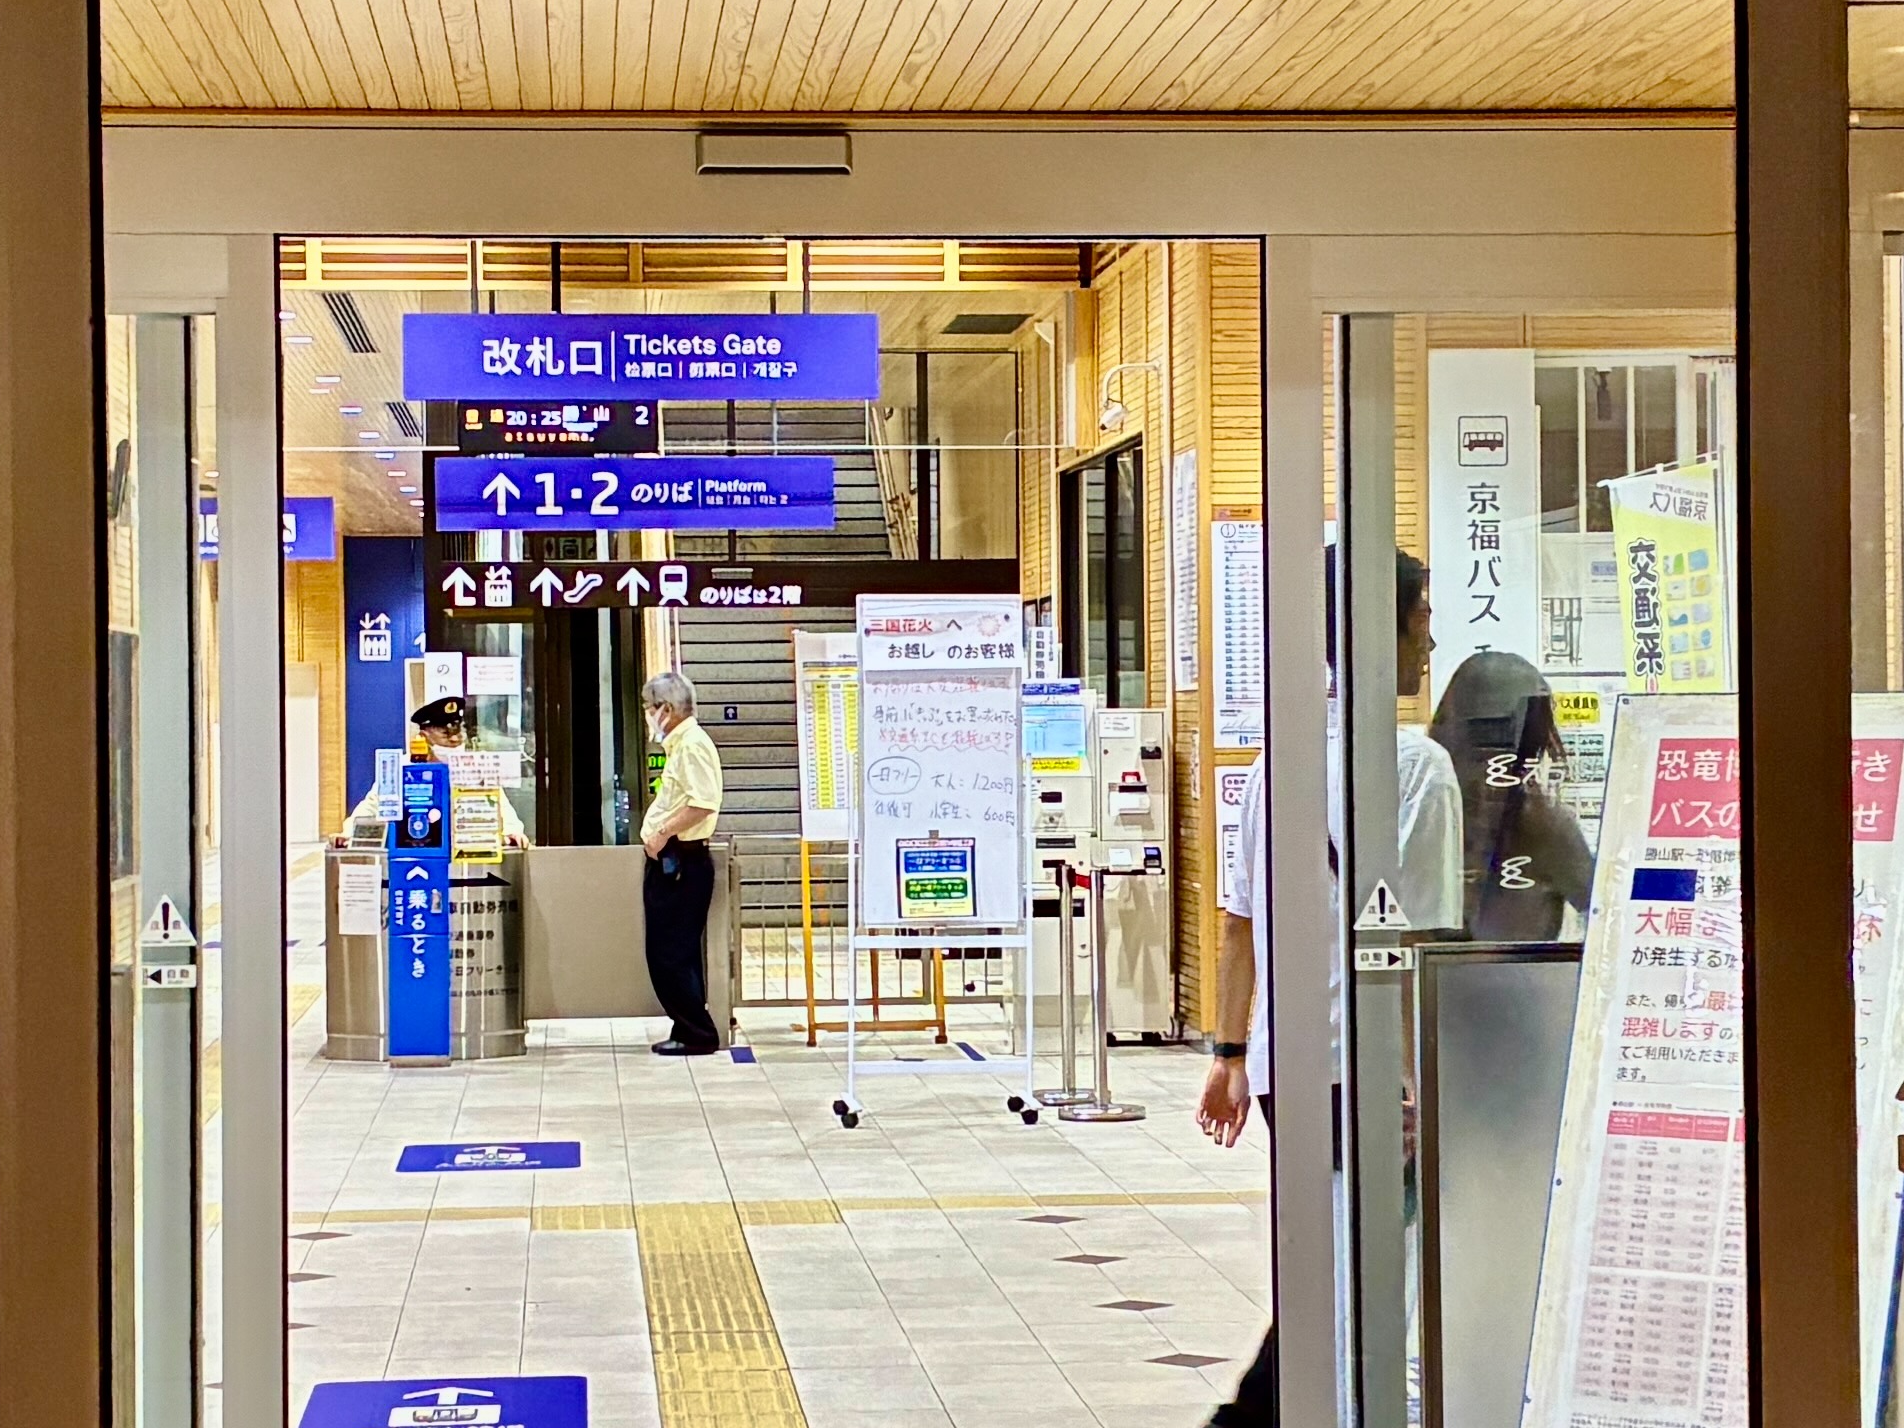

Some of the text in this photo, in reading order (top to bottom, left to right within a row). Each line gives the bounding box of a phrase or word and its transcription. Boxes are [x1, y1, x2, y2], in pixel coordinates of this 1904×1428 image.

[624, 333, 782, 356] Tickets Gate
[483, 336, 603, 376] 改札口
[506, 410, 562, 426] 20:25
[635, 405, 649, 426] 2
[630, 480, 694, 503] のりば
[704, 479, 767, 493] Platform
[1467, 482, 1502, 623] 京福バス
[699, 585, 802, 605] のりばは2階
[868, 618, 934, 633] 三国花火
[888, 643, 1015, 659] お越し のお客様
[407, 889, 429, 978] 乗るとき
